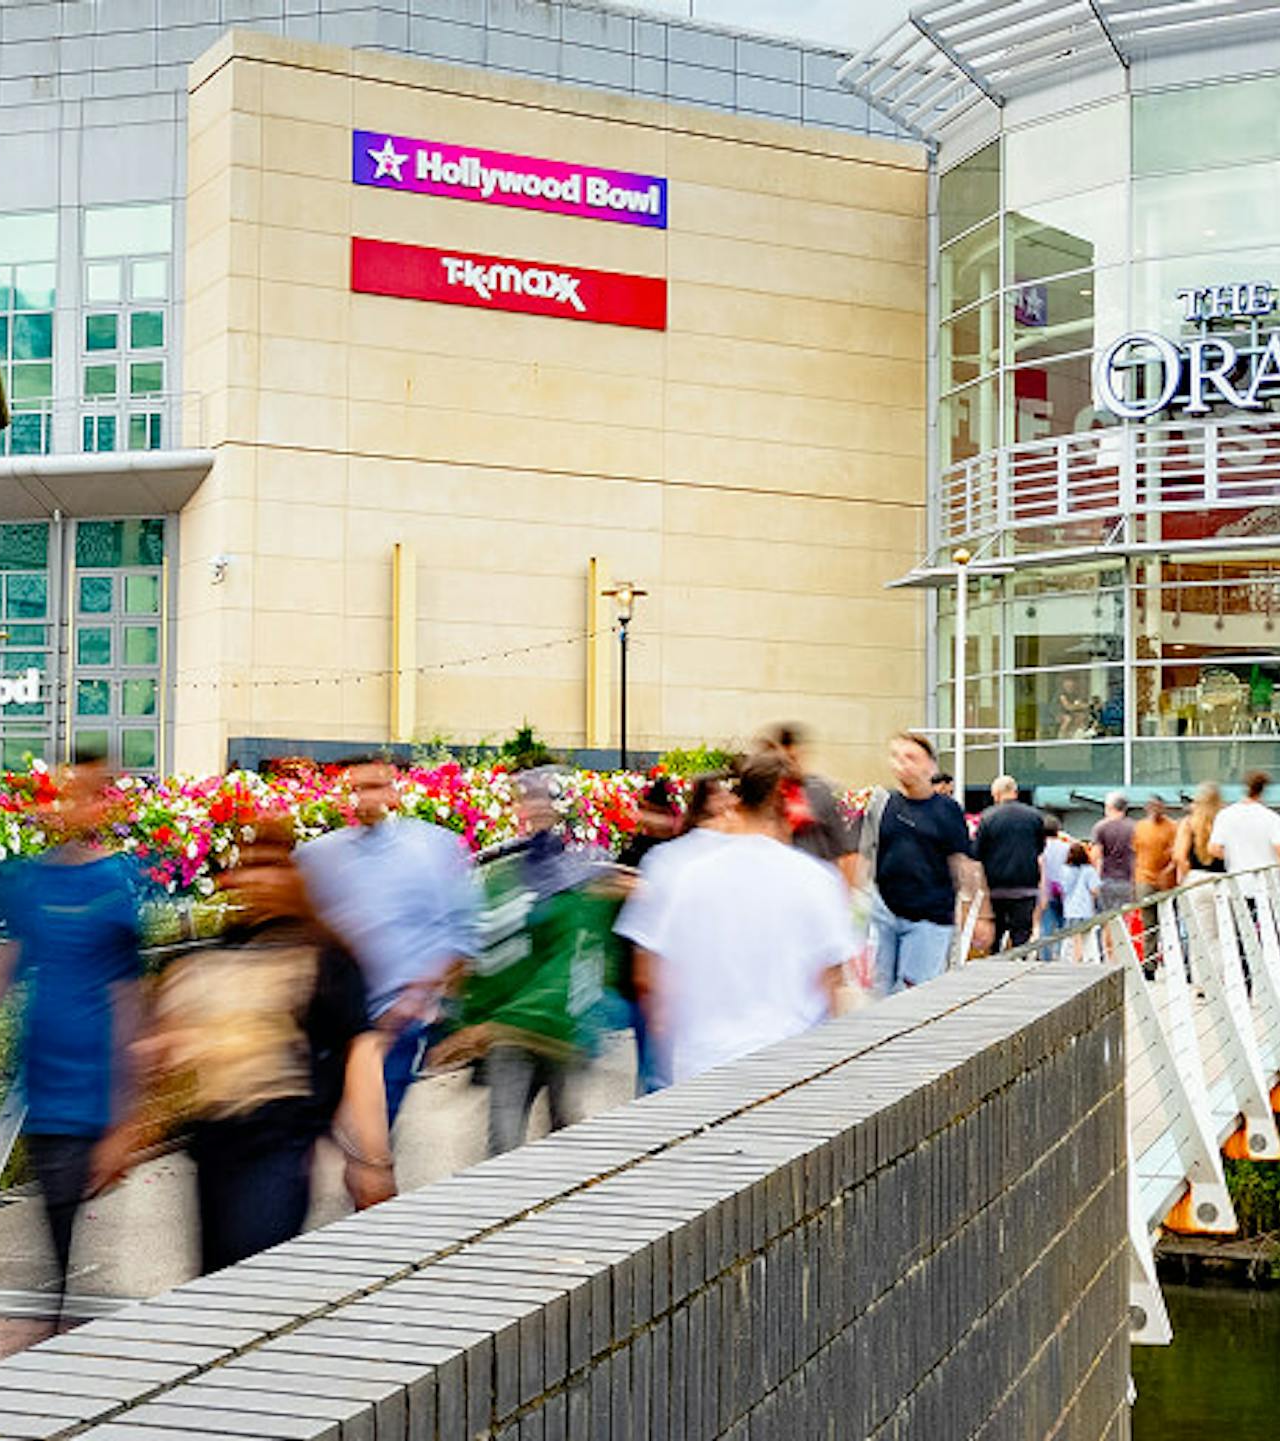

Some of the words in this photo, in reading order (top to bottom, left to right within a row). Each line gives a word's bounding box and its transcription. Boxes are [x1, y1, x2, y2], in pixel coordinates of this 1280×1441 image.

[415, 149, 581, 205] Hollywood
[586, 175, 661, 216] Bowl
[1177, 280, 1279, 323] THE
